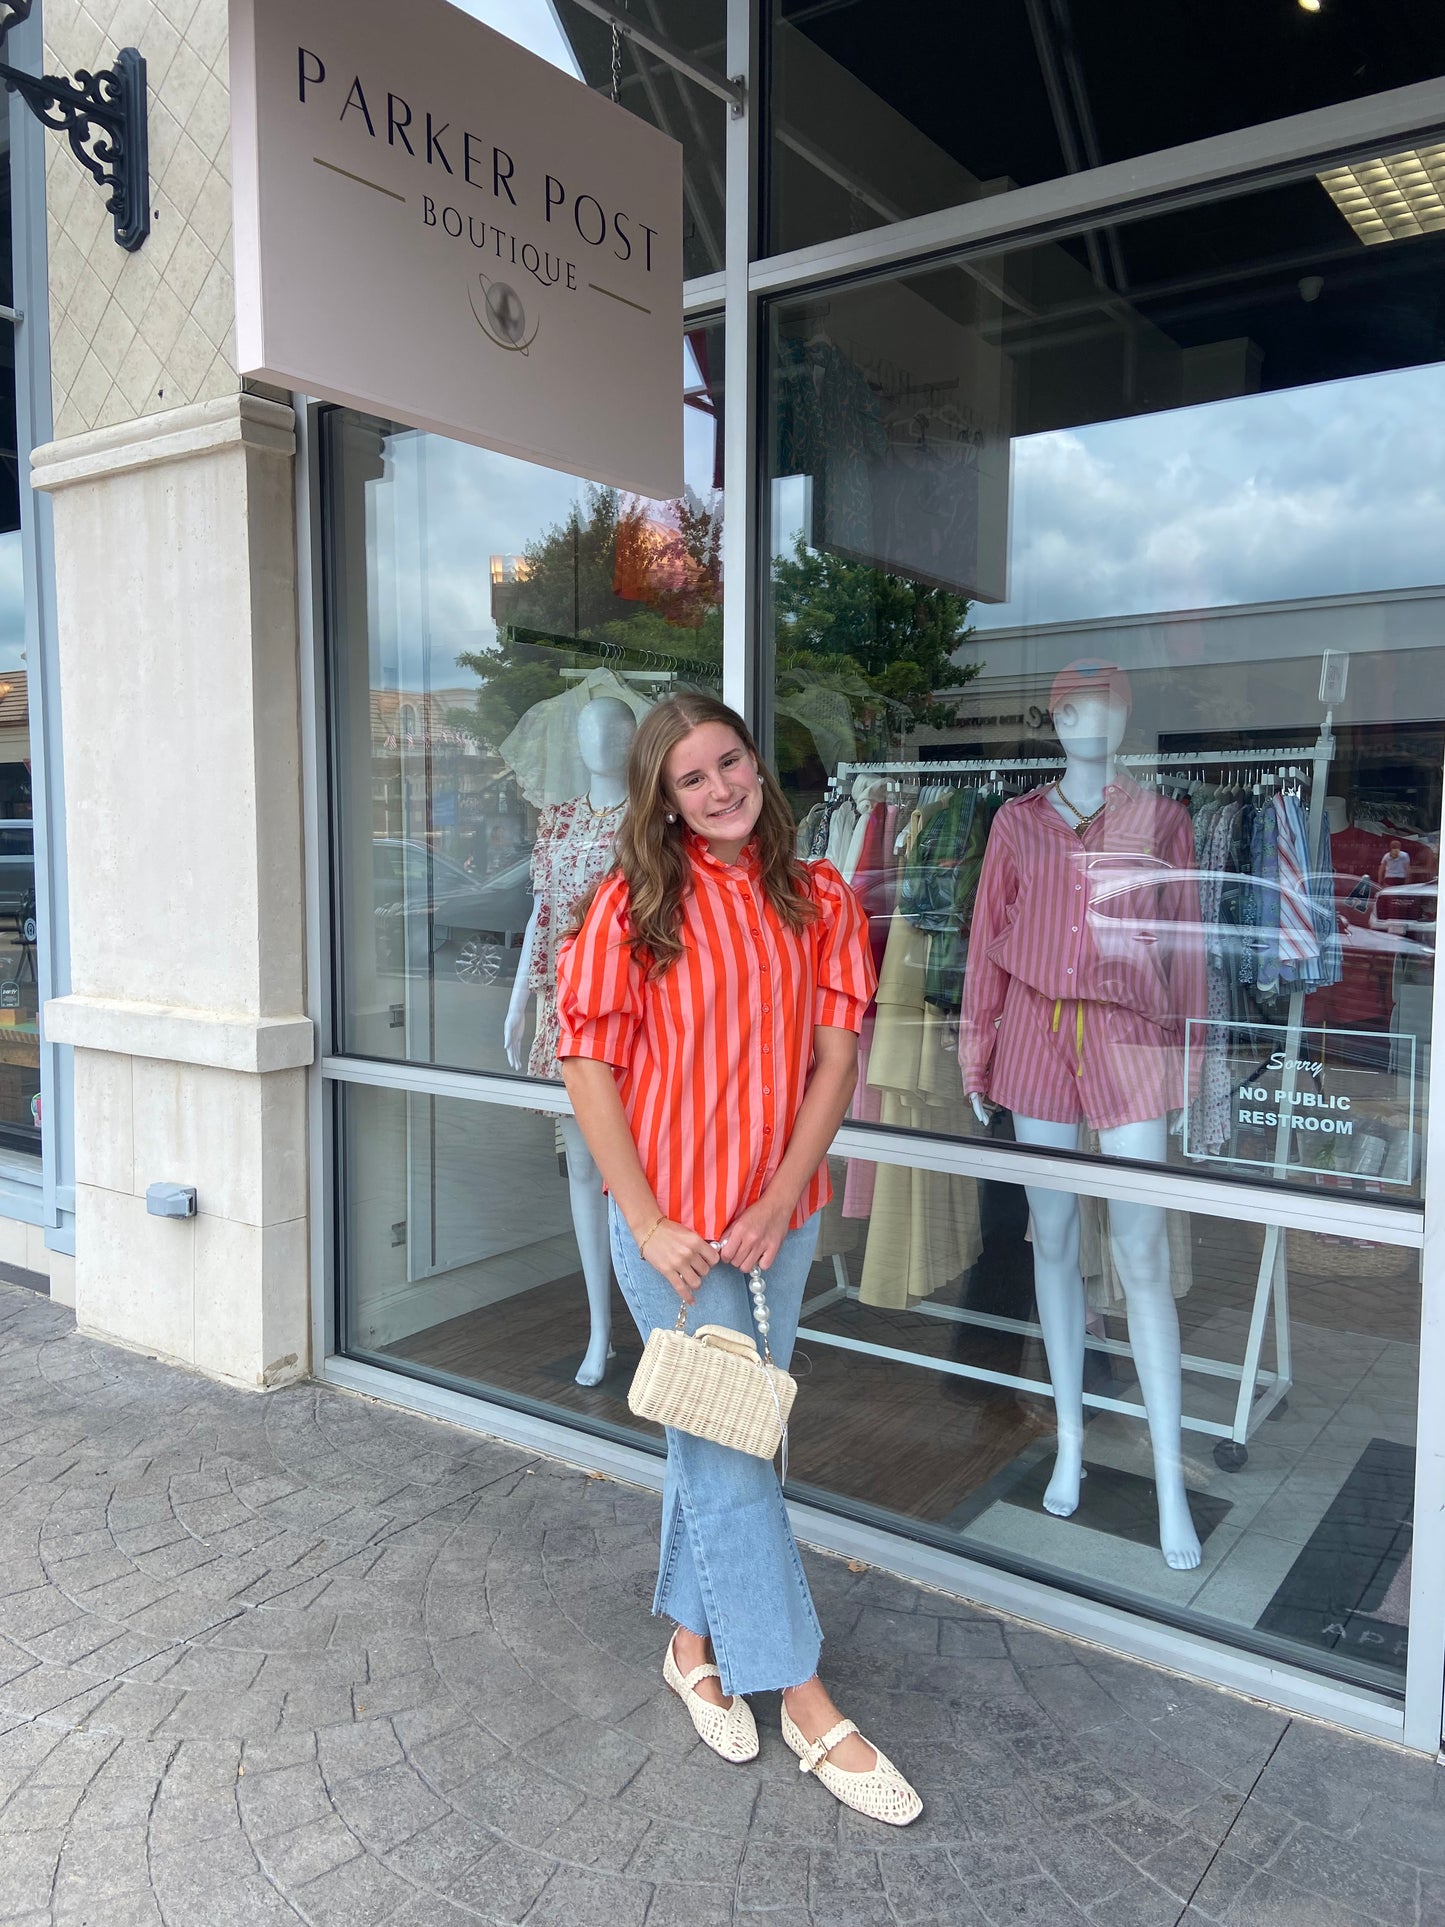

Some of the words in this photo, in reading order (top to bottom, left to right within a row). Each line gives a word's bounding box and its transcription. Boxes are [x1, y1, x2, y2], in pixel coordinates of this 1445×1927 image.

[298, 46, 517, 206] PARKER
[545, 174, 659, 272] POST
[422, 195, 578, 291] BOUTIQUE
[1266, 1052, 1323, 1078] Sorry
[1239, 1086, 1268, 1102] NO
[1274, 1090, 1351, 1110] PUBLIC
[1238, 1110, 1353, 1135] RESTROOM
